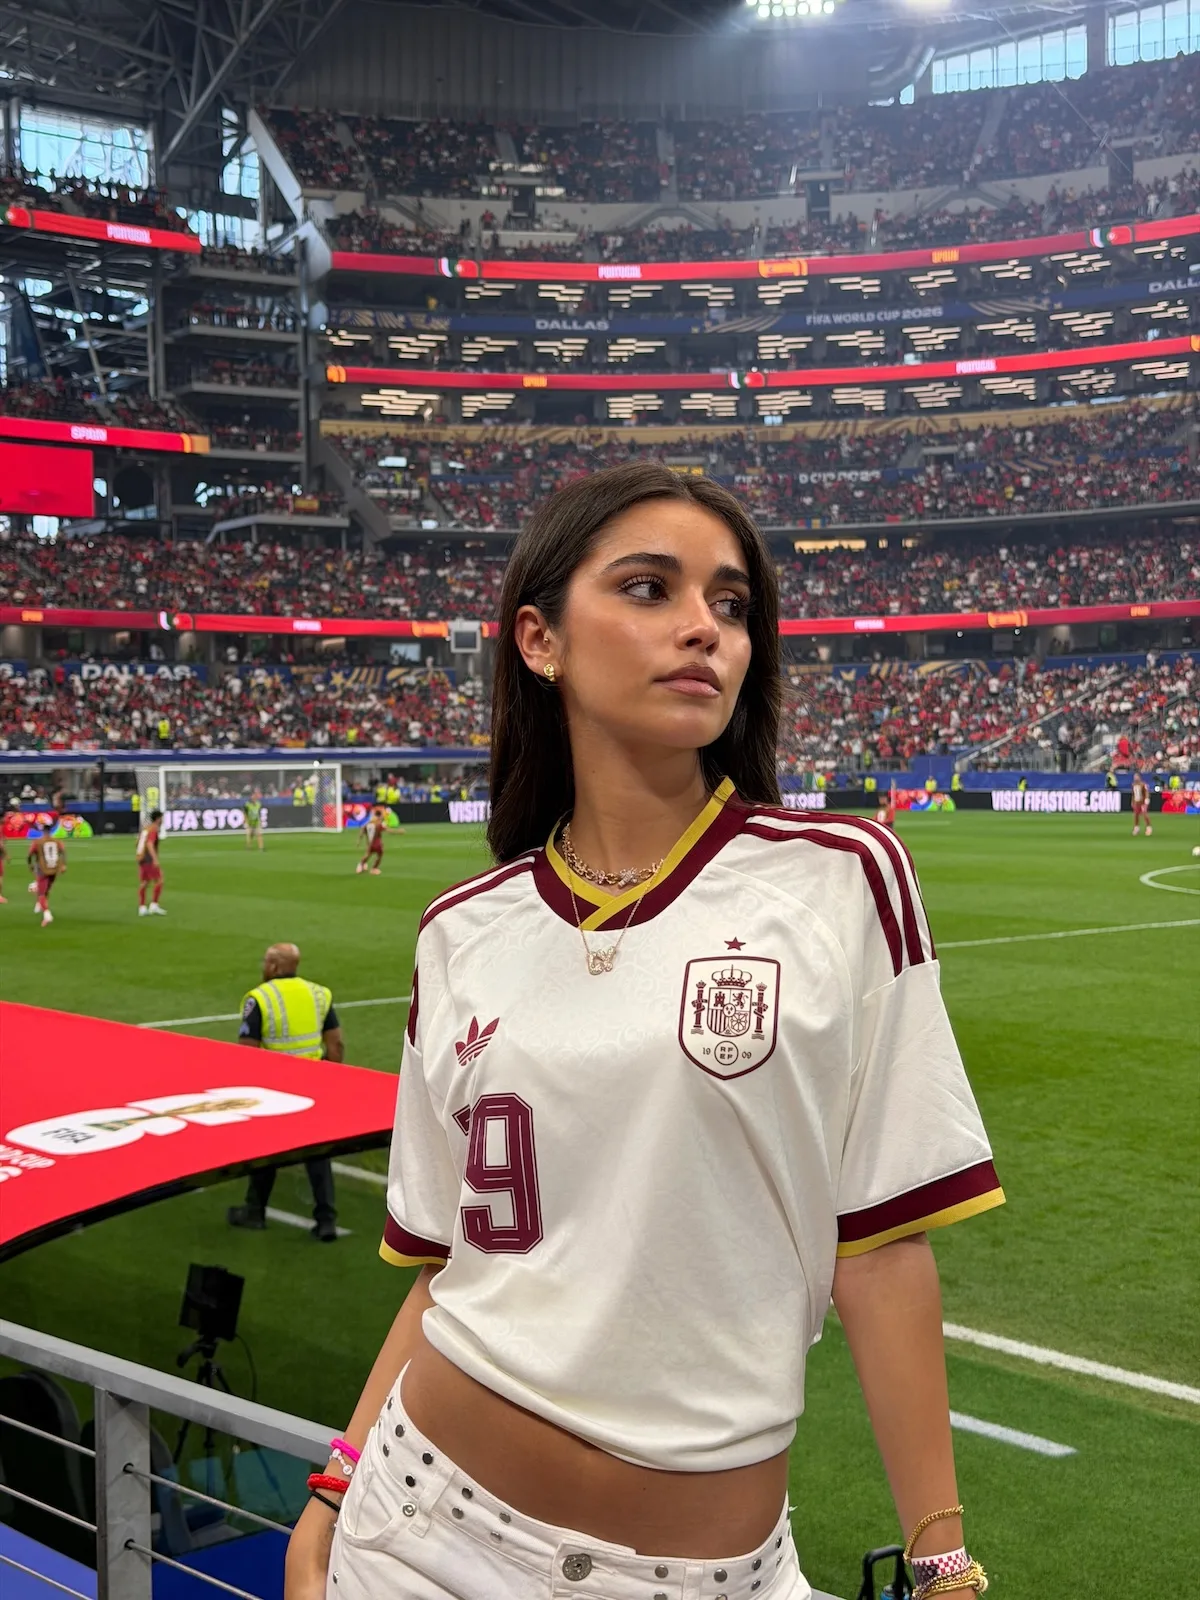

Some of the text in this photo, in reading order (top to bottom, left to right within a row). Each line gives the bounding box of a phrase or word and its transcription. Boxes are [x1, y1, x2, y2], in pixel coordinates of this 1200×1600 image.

[1148, 277, 1200, 293] DALL
[806, 306, 943, 325] FIFA WORLD CUP 2026
[535, 318, 610, 331] DALLAS
[992, 790, 1023, 812] VISIT
[1025, 790, 1121, 813] FIFASTORE.COM
[164, 808, 268, 831] IFA STOE
[448, 800, 487, 823] VISIT
[702, 1047, 711, 1056] 19
[741, 1051, 752, 1060] 09
[40, 1127, 97, 1144] FIFA
